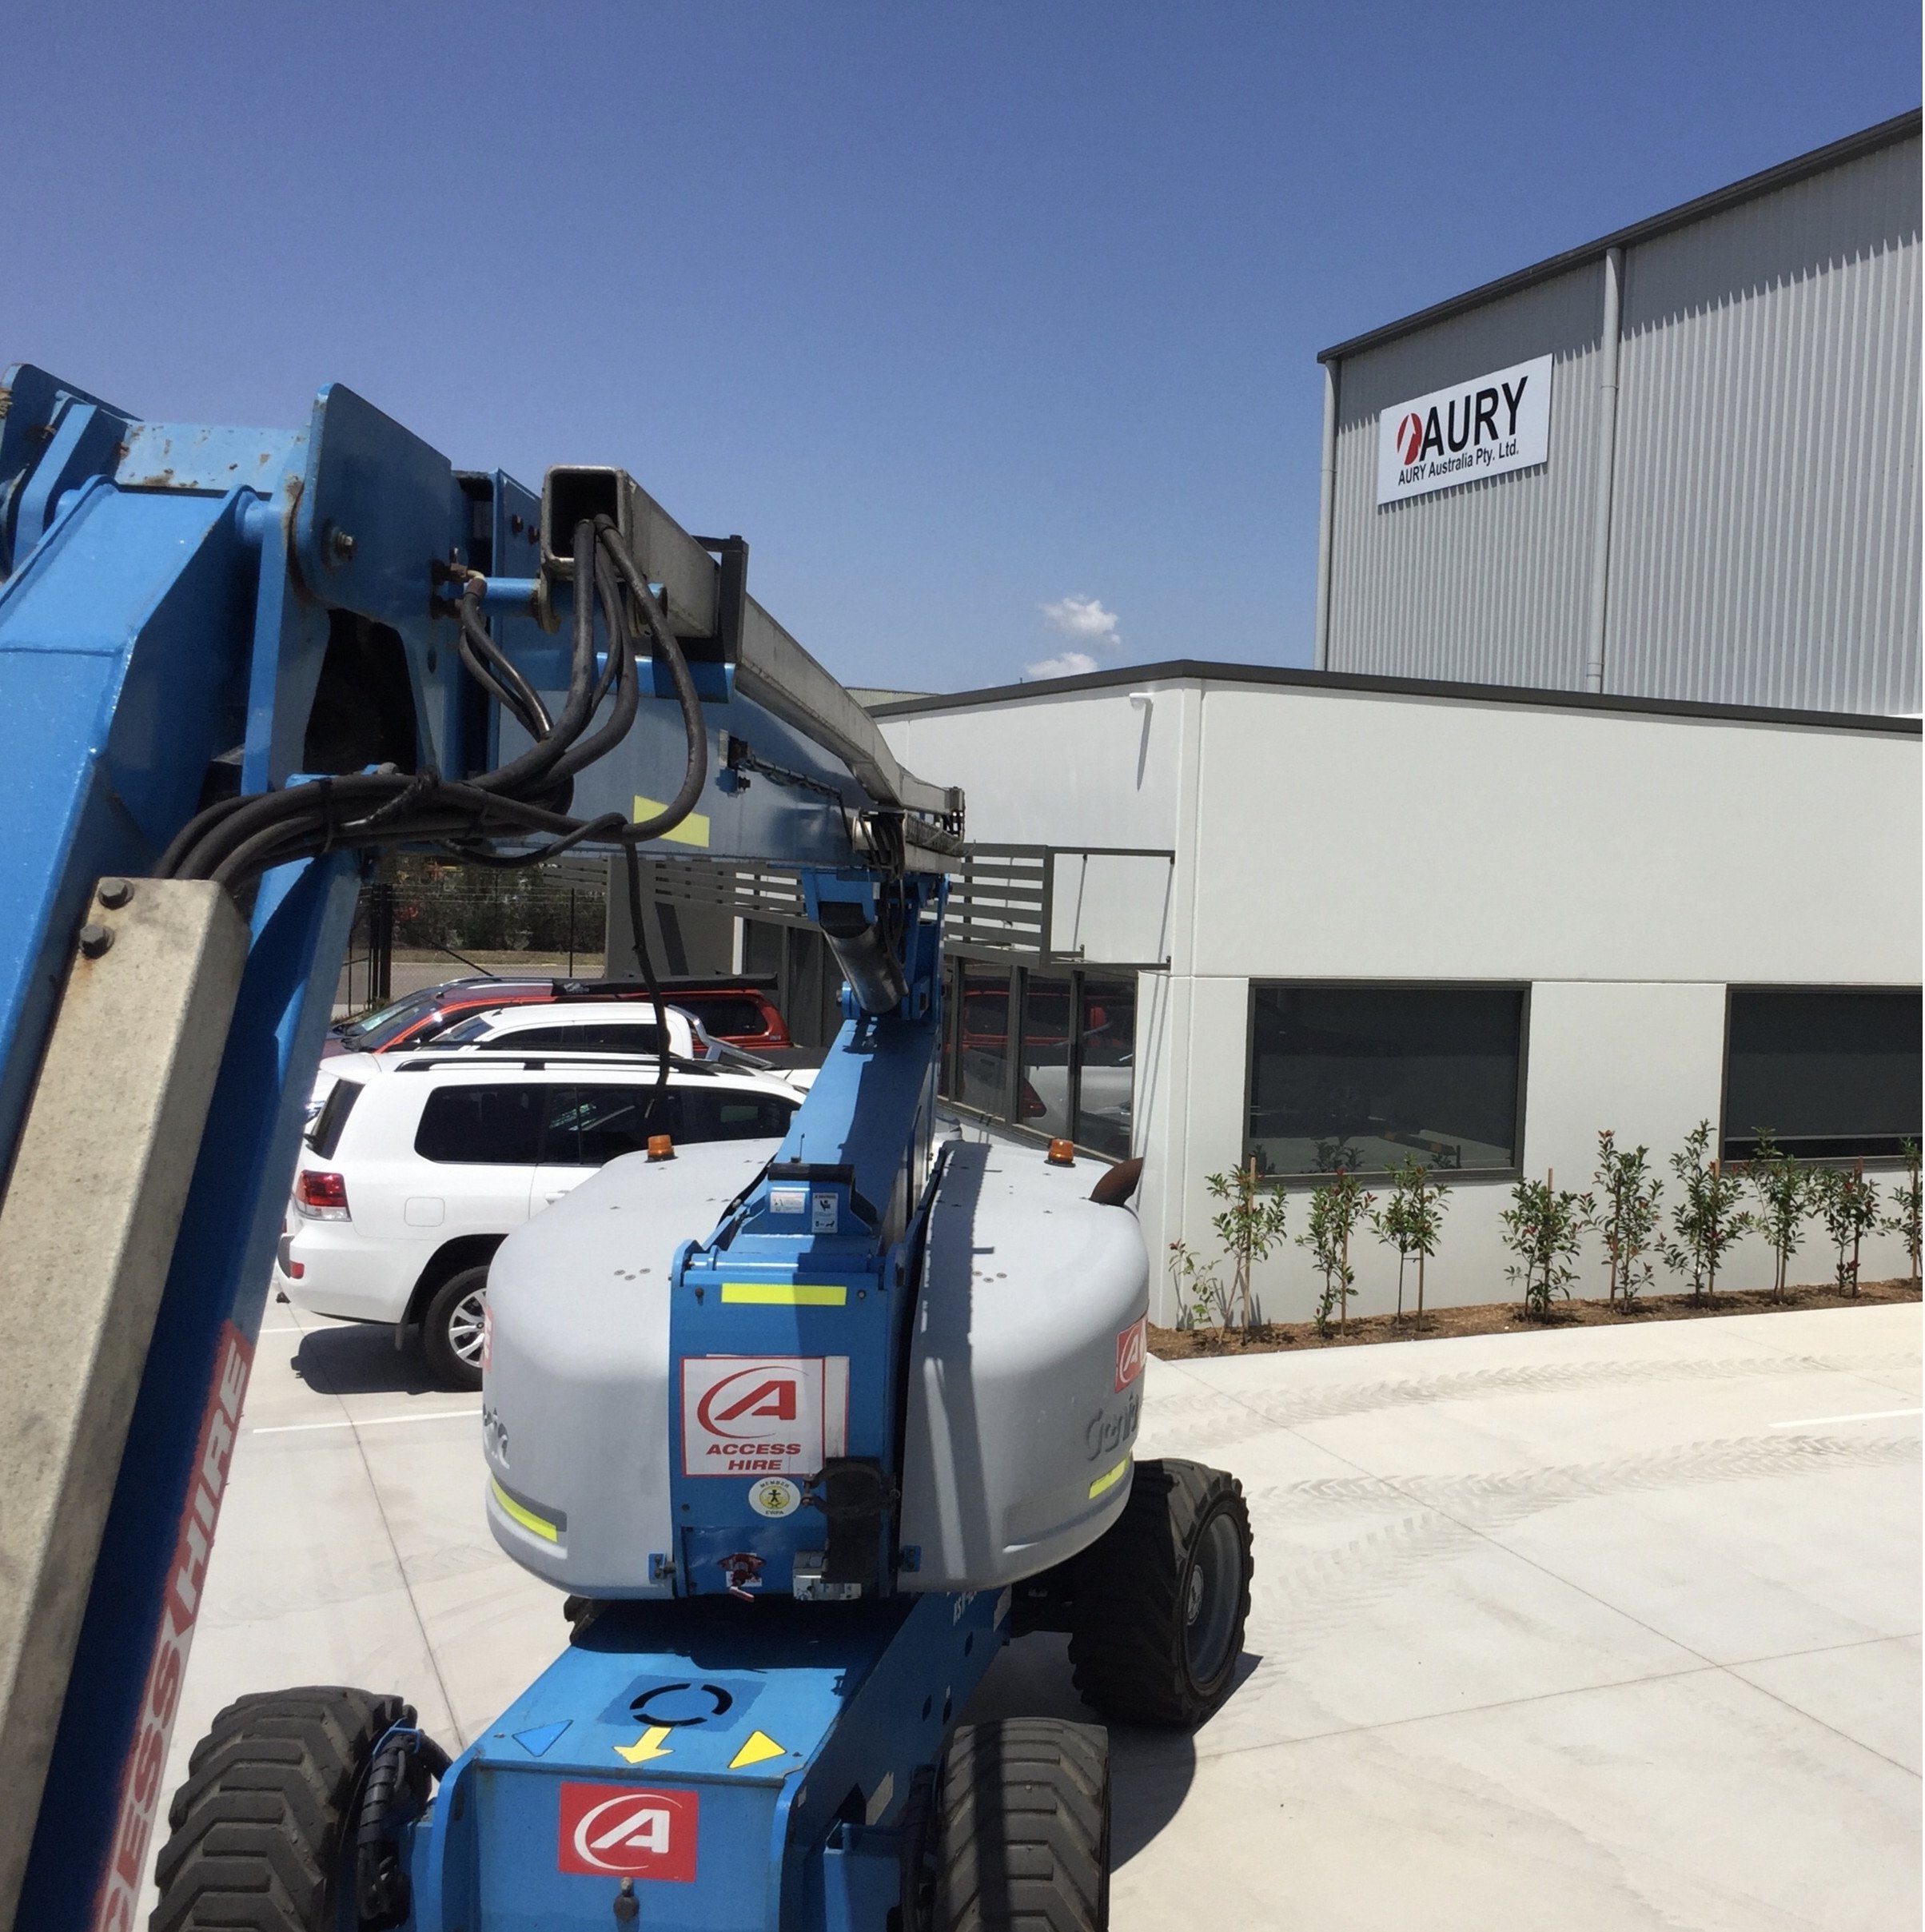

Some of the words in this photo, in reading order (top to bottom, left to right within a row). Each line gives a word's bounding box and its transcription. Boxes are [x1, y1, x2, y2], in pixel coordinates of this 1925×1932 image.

[1420, 376, 1528, 461] AURY
[1398, 464, 1428, 485] AURY
[1429, 453, 1473, 477] Australia
[1476, 448, 1496, 467] Pty.
[1498, 439, 1520, 460] Ltd.
[706, 1443, 802, 1455] ACCESS
[727, 1460, 782, 1470] HIRE
[174, 1338, 248, 1614] HIRE
